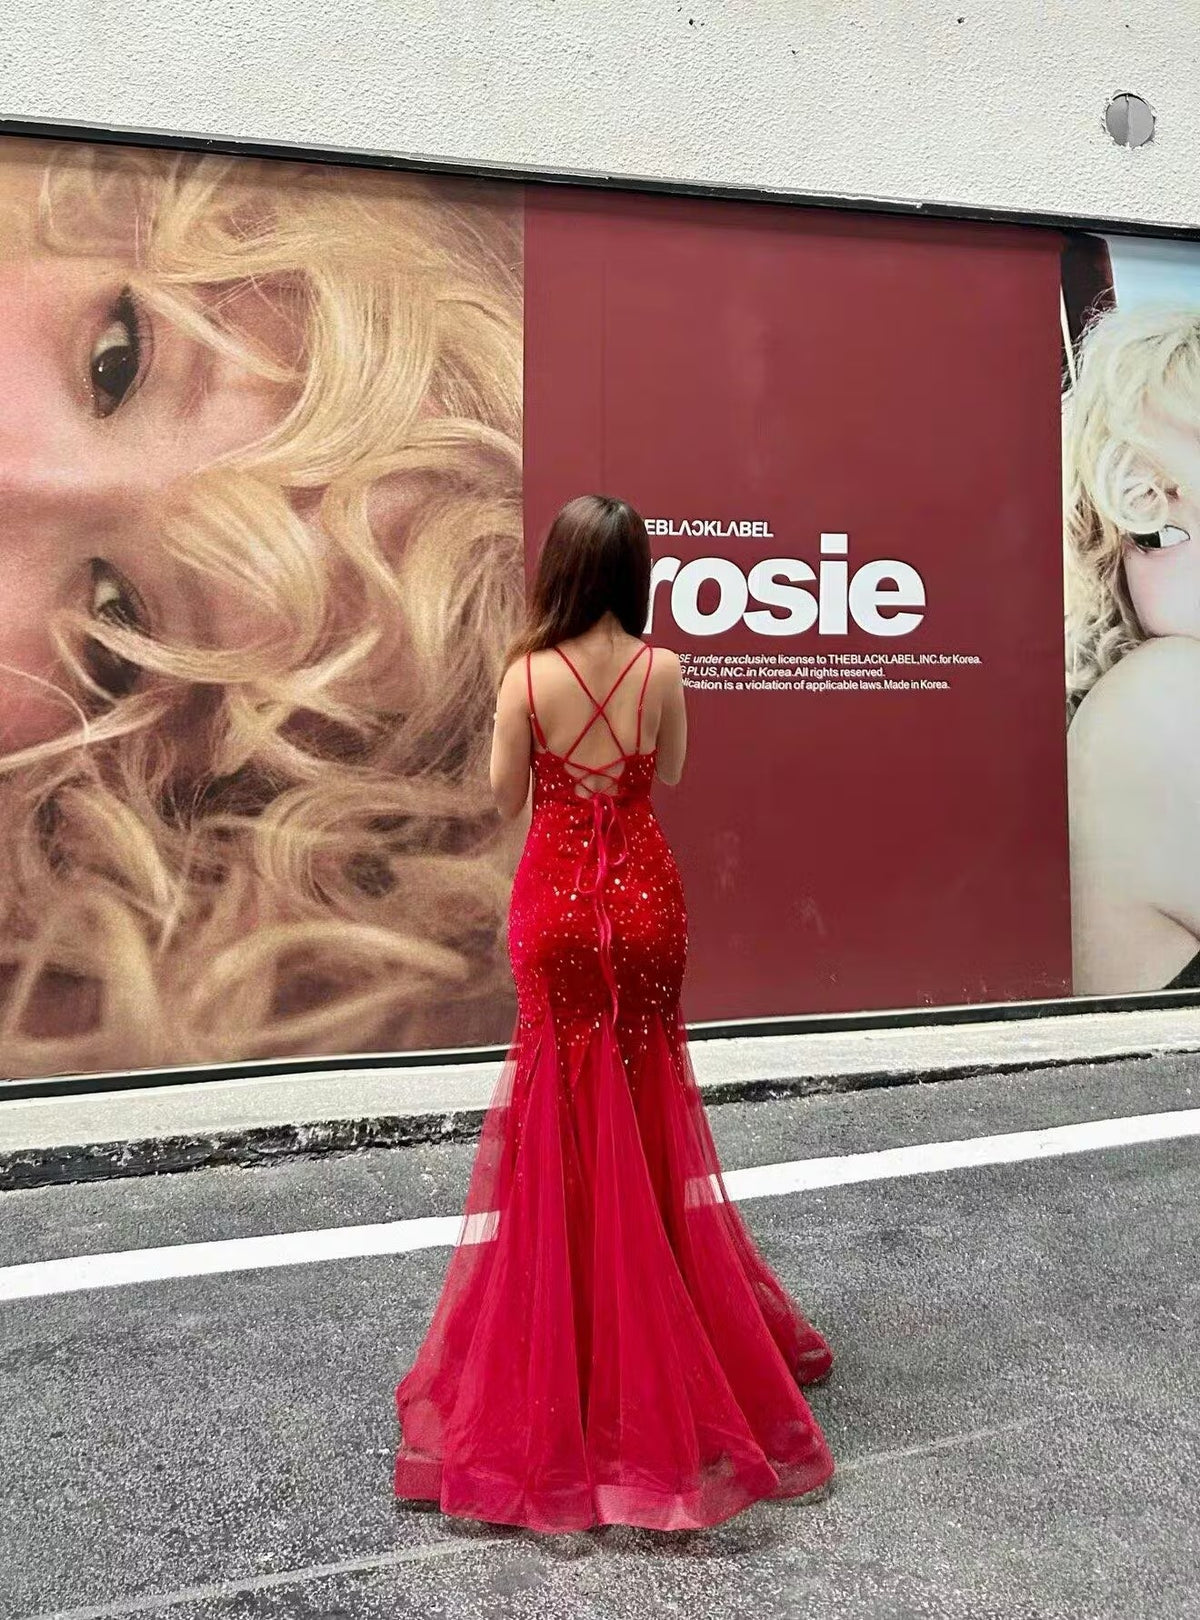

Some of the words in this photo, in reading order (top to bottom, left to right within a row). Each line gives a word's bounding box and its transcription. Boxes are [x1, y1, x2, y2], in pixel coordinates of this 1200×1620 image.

[644, 519, 774, 537] EBLACKLABEL
[643, 533, 926, 636] rosie
[678, 653, 692, 663] SE
[693, 654, 723, 664] under
[724, 654, 777, 664] exclusive
[778, 654, 816, 664] license
[816, 655, 827, 664] to
[953, 654, 982, 664] Korea.
[810, 667, 839, 679] rights
[840, 667, 886, 677] reserved.
[724, 680, 734, 690] is
[735, 681, 744, 690] a
[745, 680, 792, 690] violation
[793, 680, 805, 690] of
[805, 680, 859, 692] applicable
[911, 680, 919, 689] in
[920, 679, 951, 689] Korea.
